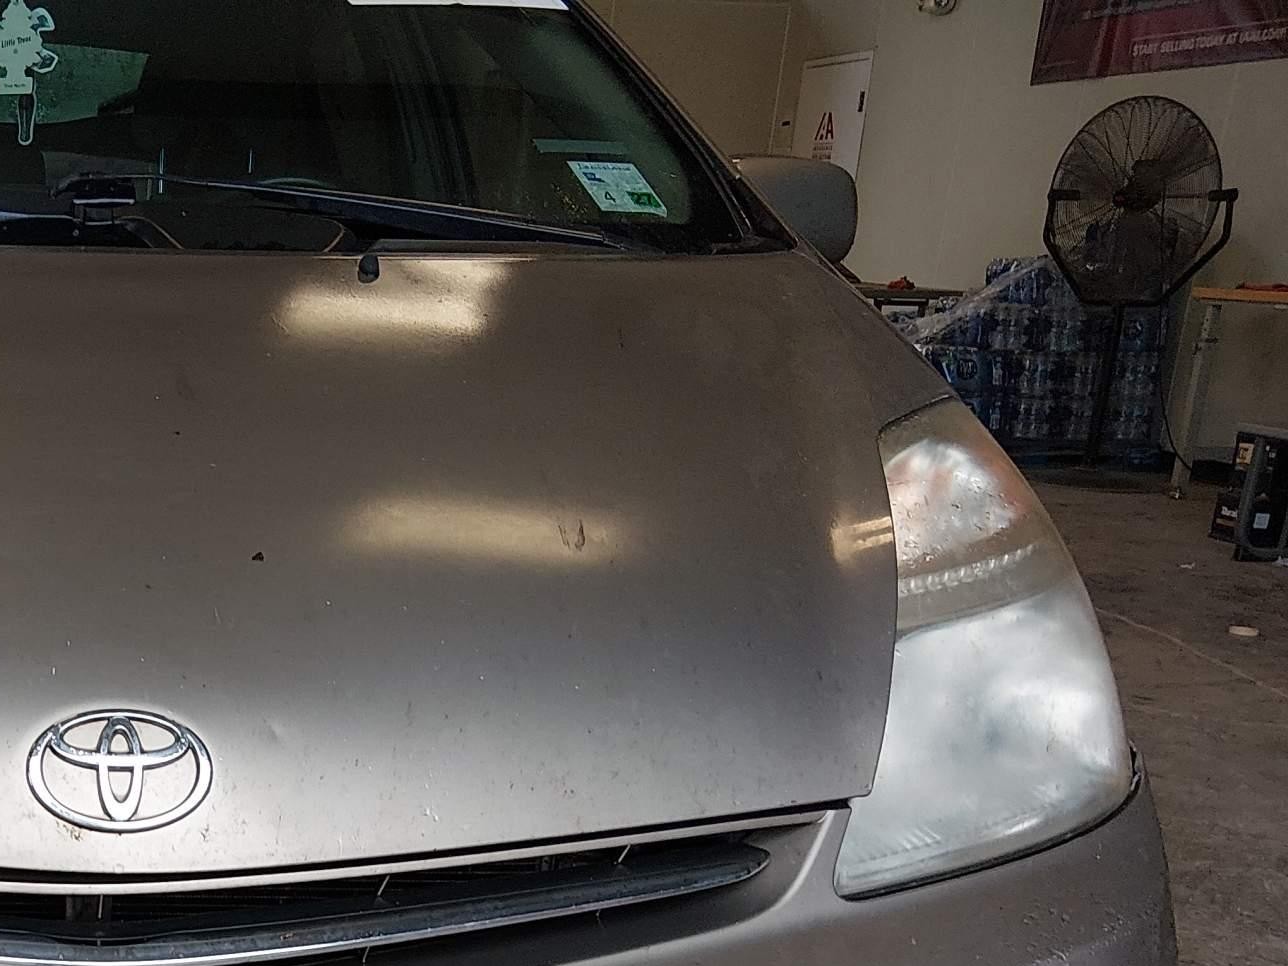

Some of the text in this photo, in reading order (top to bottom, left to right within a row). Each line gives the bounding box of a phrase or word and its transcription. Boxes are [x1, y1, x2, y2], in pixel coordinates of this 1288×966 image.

[1, 39, 16, 48] Little
[1133, 43, 1158, 57] START
[1160, 39, 1194, 53] SELLING
[1196, 36, 1224, 49] TODAY
[605, 191, 616, 203] 4
